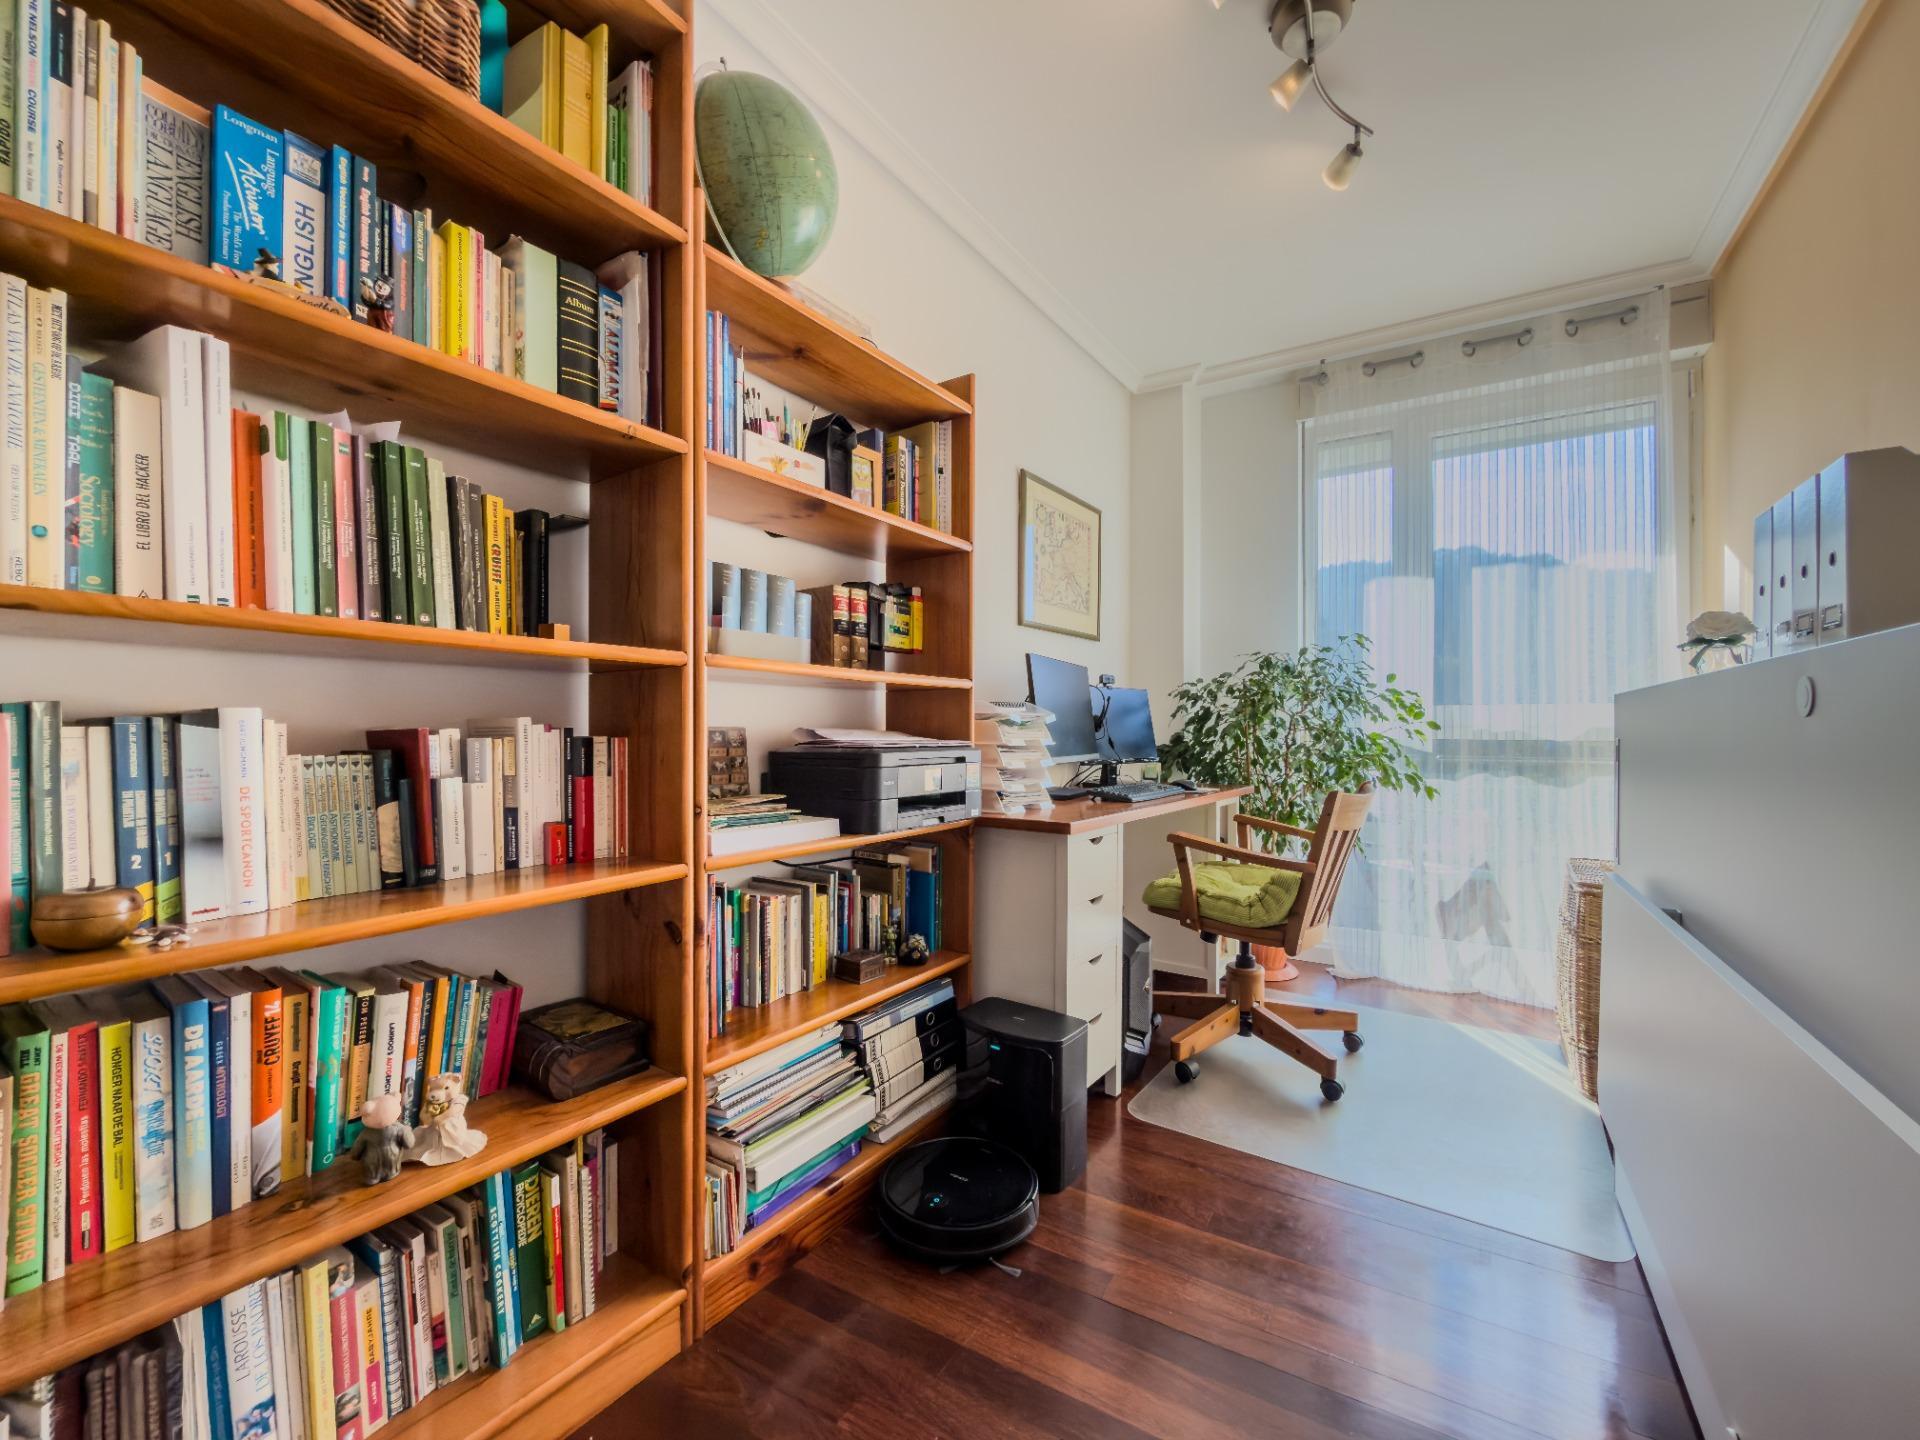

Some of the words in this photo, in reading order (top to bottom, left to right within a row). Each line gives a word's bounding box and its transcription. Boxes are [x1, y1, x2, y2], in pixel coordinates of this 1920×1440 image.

[28, 13, 37, 57] NELSON
[27, 88, 37, 134] COURSE
[223, 112, 278, 144] Longman
[260, 147, 279, 198] Language
[145, 139, 174, 251] LANGUAGE
[175, 153, 203, 243] ENGLISH
[237, 156, 267, 236] Activator
[7, 281, 25, 325] ATLAS
[565, 296, 595, 314] Album
[7, 328, 23, 354] VAN
[7, 357, 22, 377] DE
[32, 362, 48, 425] GESTEENTEN
[69, 382, 81, 418] DIGI
[7, 380, 23, 449] ANATOMIE
[32, 437, 48, 496] MINERALEN
[67, 434, 80, 469] TAAL
[135, 453, 150, 490] HACKER
[79, 473, 101, 548] Sociology
[135, 493, 149, 509] DEL
[135, 511, 149, 538] LIBRO
[136, 540, 149, 551] EL
[239, 719, 248, 737] BART
[239, 738, 248, 778] JUNGMANN
[239, 786, 250, 802] DE
[240, 805, 254, 888] SPORTCANON
[306, 815, 317, 850] BIOLOGIE
[329, 813, 340, 862] ASTRONOMIE
[354, 810, 365, 845] WISKUNDE
[131, 855, 142, 870] 2
[164, 852, 172, 866] 1
[264, 999, 281, 1017] 14
[359, 996, 368, 1014] TOM
[184, 1024, 204, 1053] DE
[263, 1016, 281, 1066] CRUYFF
[358, 1017, 368, 1045] PETERS
[20, 1050, 30, 1068] HILL
[112, 1046, 123, 1088] HONGER
[20, 1071, 40, 1128] GREAT
[78, 1068, 88, 1112] FERNANDO
[112, 1089, 122, 1114] NAAR
[185, 1054, 205, 1121] AARDE
[216, 1067, 227, 1119] MYTHOLOGY
[79, 1115, 88, 1153] molestias
[113, 1116, 123, 1129] DE
[113, 1131, 124, 1148] BAL
[18, 1135, 39, 1206] SOCCER
[79, 1154, 88, 1166] las
[79, 1167, 90, 1205] Perdonen
[515, 1183, 528, 1248] ENCYCLOPEDIE
[525, 1173, 542, 1243] DIEREN
[15, 1205, 38, 1265] STARS
[490, 1207, 503, 1260] SCOTTISH
[495, 1264, 505, 1315] COOKERY
[230, 1304, 251, 1383] LAROUSSE
[253, 1340, 266, 1369] LOS
[365, 1307, 375, 1365] BABYJAHRE
